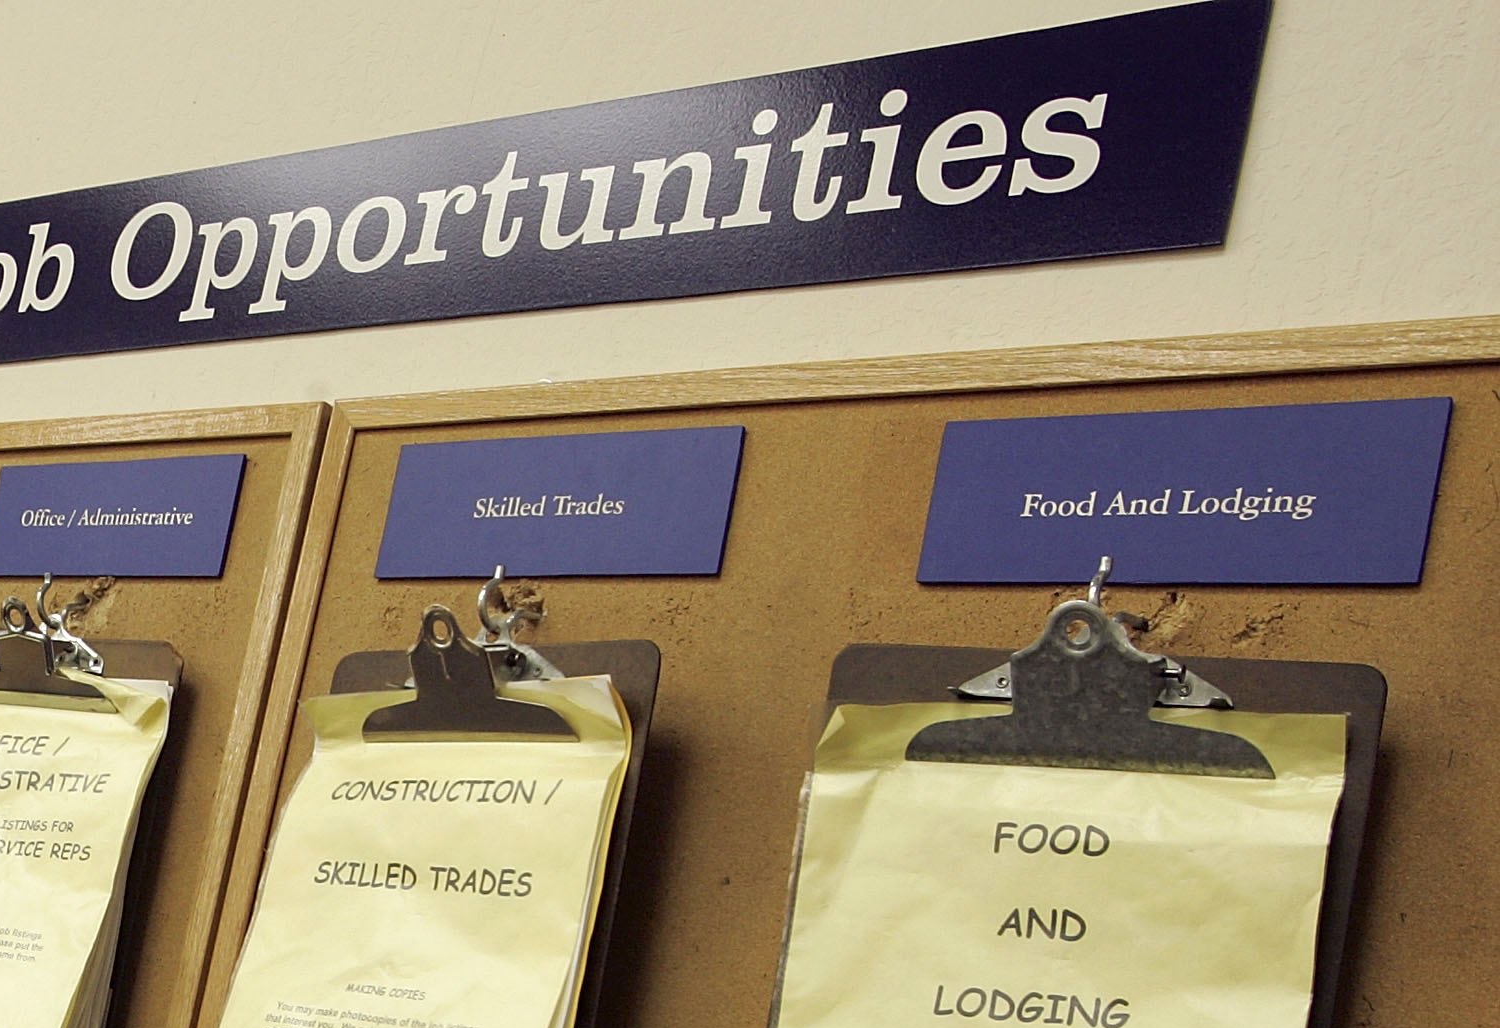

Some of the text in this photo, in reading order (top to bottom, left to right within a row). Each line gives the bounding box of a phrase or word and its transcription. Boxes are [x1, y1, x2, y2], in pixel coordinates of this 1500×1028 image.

[108, 88, 1110, 323] Opportunities
[21, 506, 193, 527] Office / Administrative
[473, 493, 624, 518] Skilled Trades
[1019, 487, 1316, 520] Food And Lodging
[52, 736, 70, 756] /
[331, 779, 562, 805] CONSTRUCTION /
[50, 820, 74, 832] FOR
[993, 821, 1110, 856] FOOD
[49, 842, 91, 861] REPS
[313, 860, 532, 897] SKILLED TRADES
[996, 907, 1086, 941] AND
